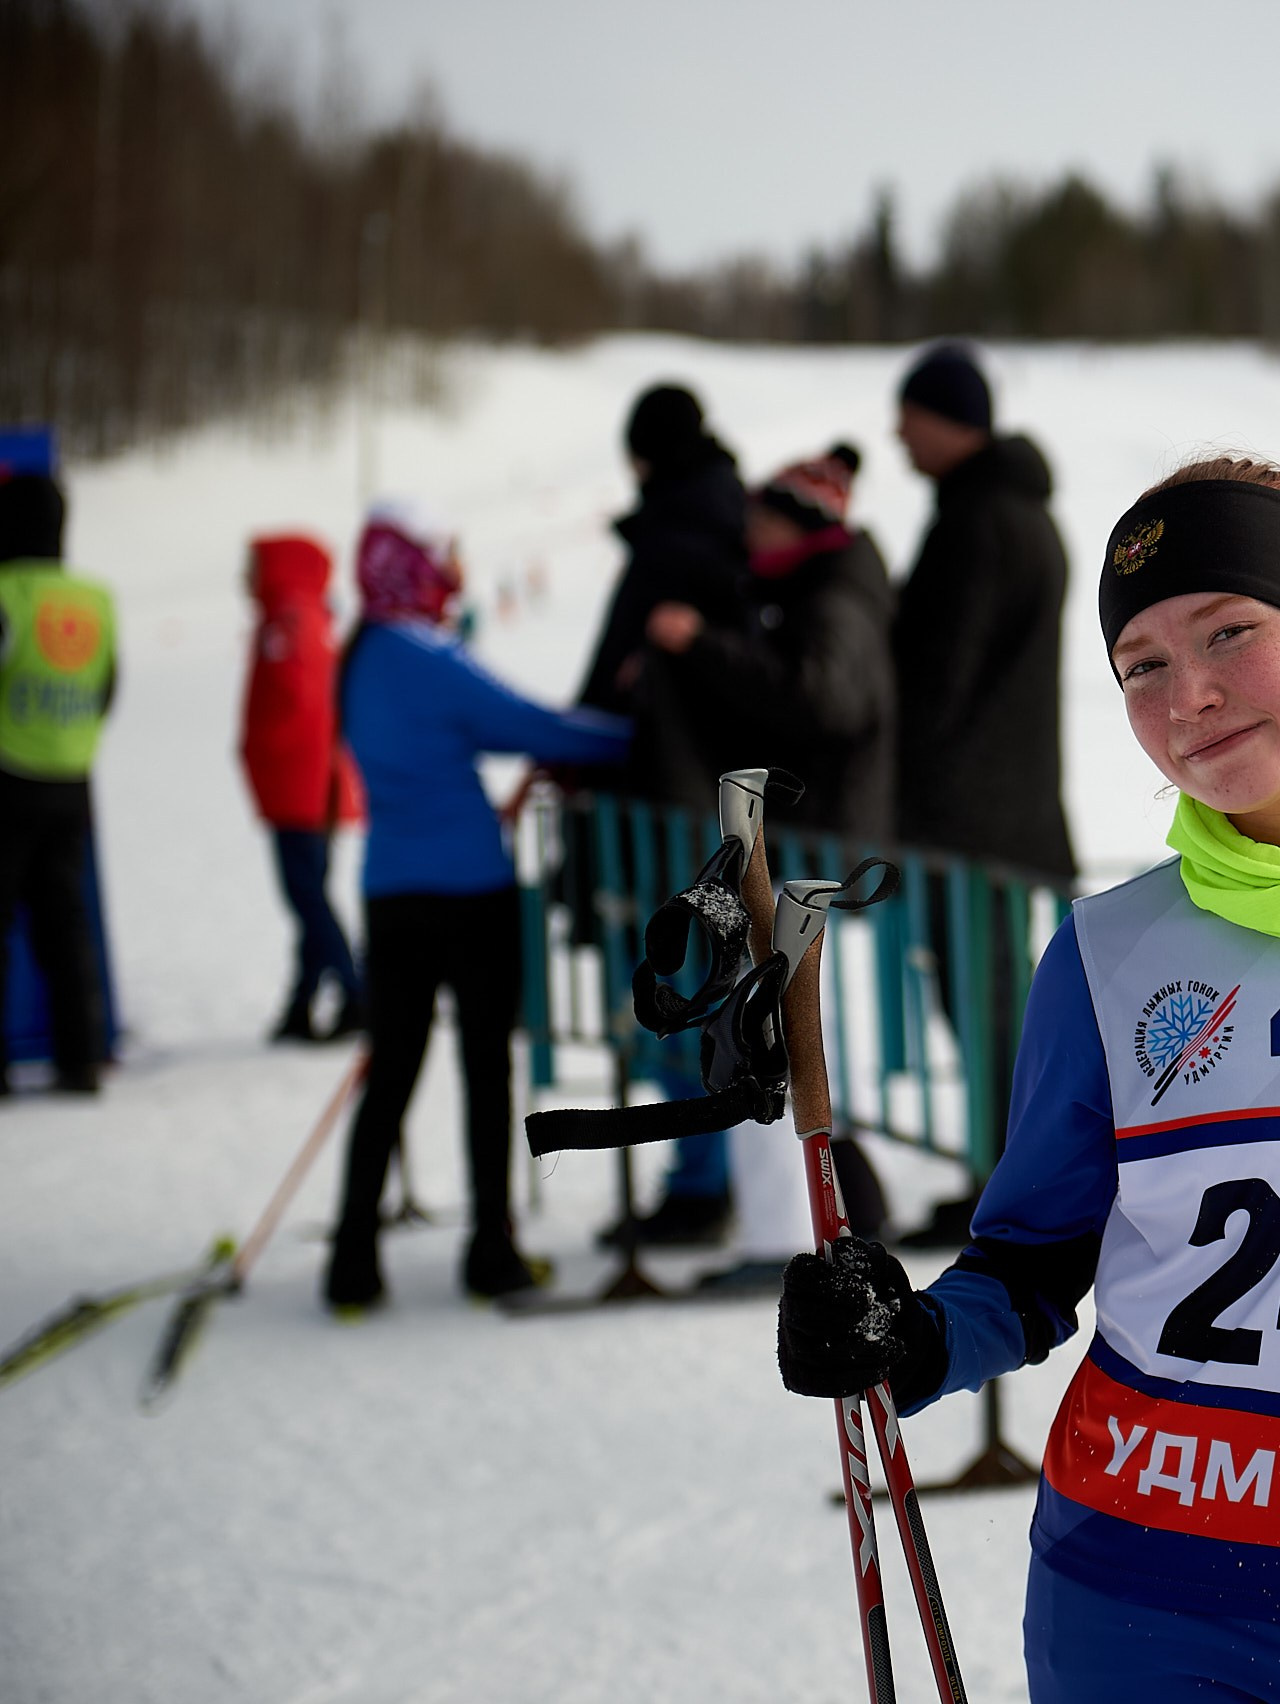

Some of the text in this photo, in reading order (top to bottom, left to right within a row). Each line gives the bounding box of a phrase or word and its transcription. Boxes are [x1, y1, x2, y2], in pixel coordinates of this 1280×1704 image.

[1134, 980, 1220, 1078] ФЕДЕРАЦИЯ ЛЫЖНЫХ ГОНОК
[1183, 1025, 1235, 1085] УДМУРТИИ
[819, 1147, 831, 1185] SWIX
